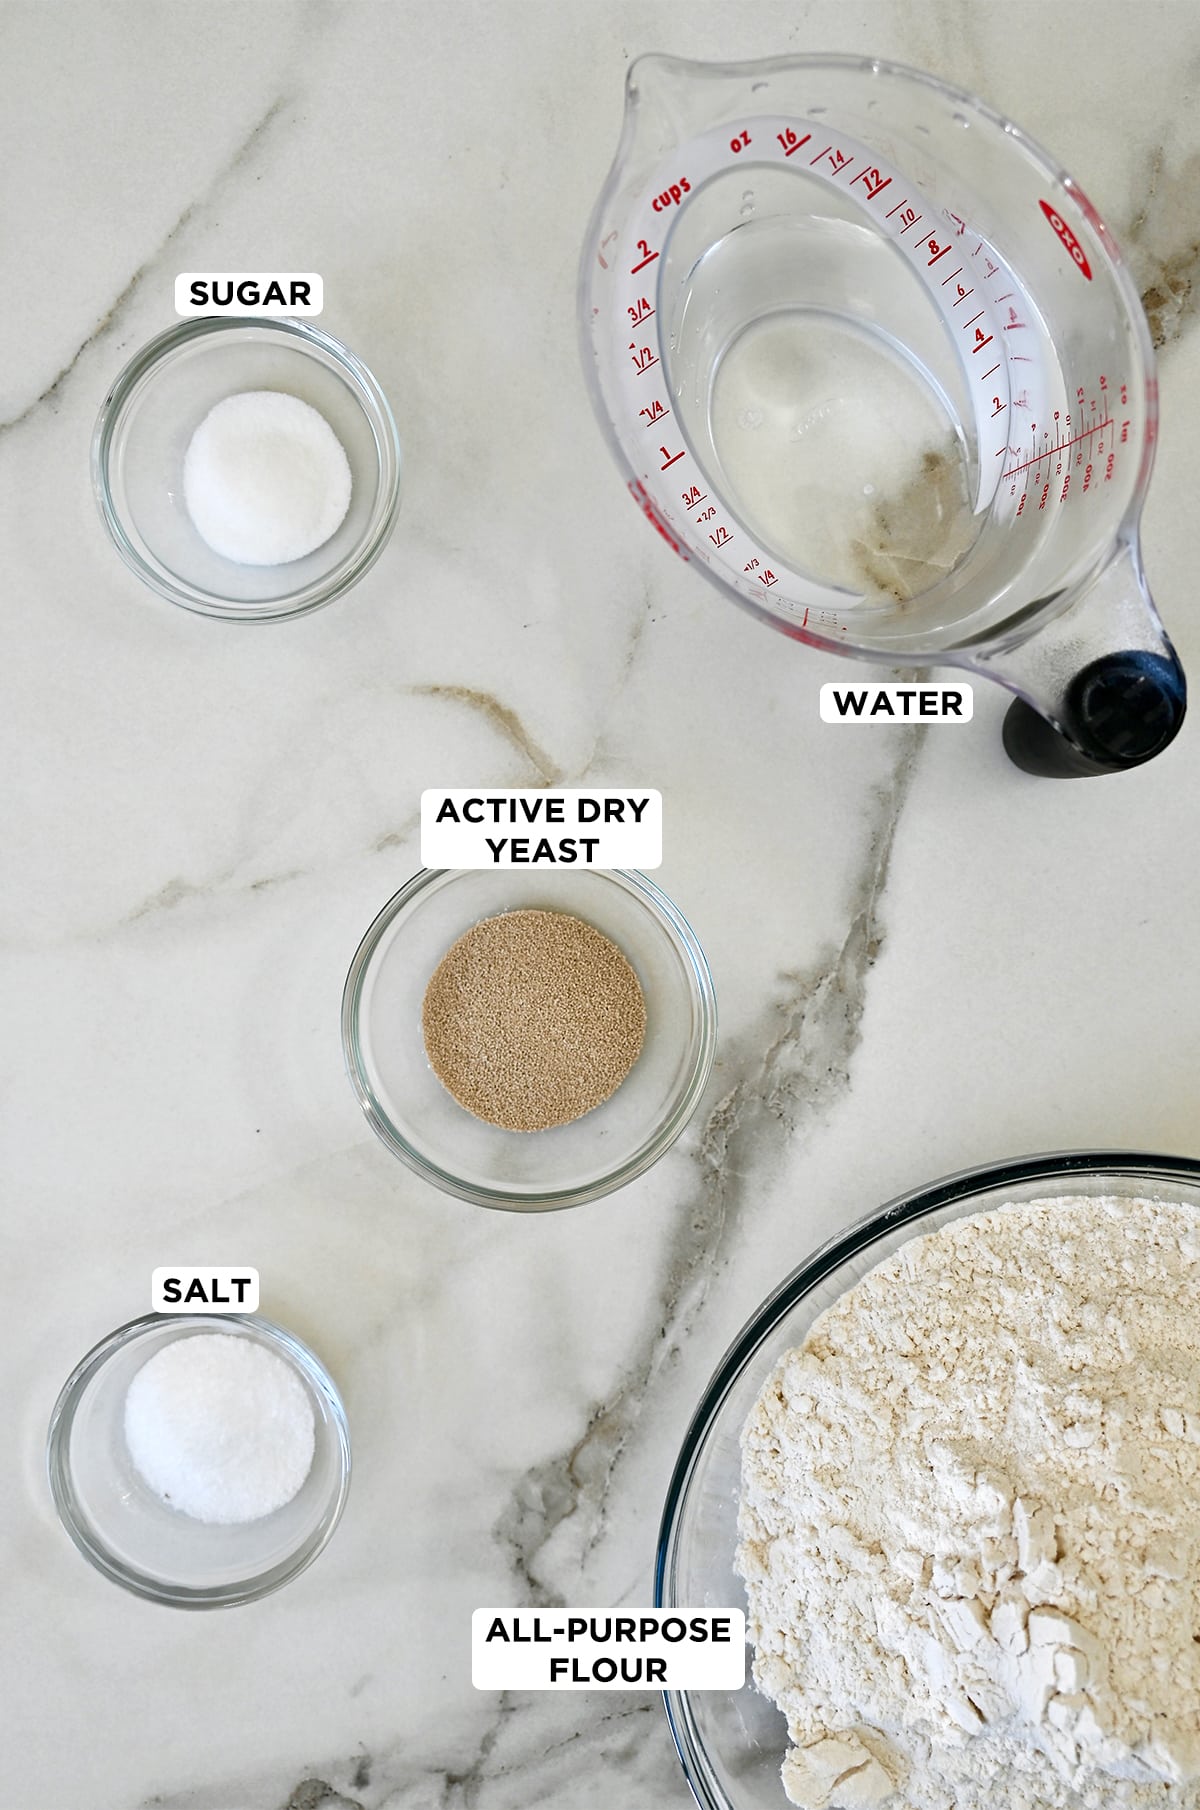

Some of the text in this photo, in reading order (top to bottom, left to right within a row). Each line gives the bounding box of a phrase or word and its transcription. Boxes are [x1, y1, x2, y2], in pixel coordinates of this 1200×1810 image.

[729, 130, 753, 154] oz
[776, 127, 797, 150] 16
[828, 149, 845, 170] 14
[862, 168, 884, 192] 12
[651, 177, 692, 213] cups
[899, 207, 916, 226] 10
[636, 239, 652, 258] 2
[927, 240, 941, 255] 8
[957, 284, 966, 297] 6
[627, 297, 652, 321] 3/4
[975, 327, 985, 343] 4
[631, 346, 655, 369] 1/2
[644, 400, 664, 421] 1/4
[992, 397, 1003, 410] 2
[681, 486, 702, 505] 3/4
[701, 507, 717, 521] 2/3
[709, 526, 730, 545] 1/2
[747, 558, 760, 570] 1/3
[758, 569, 775, 585] 1/4
